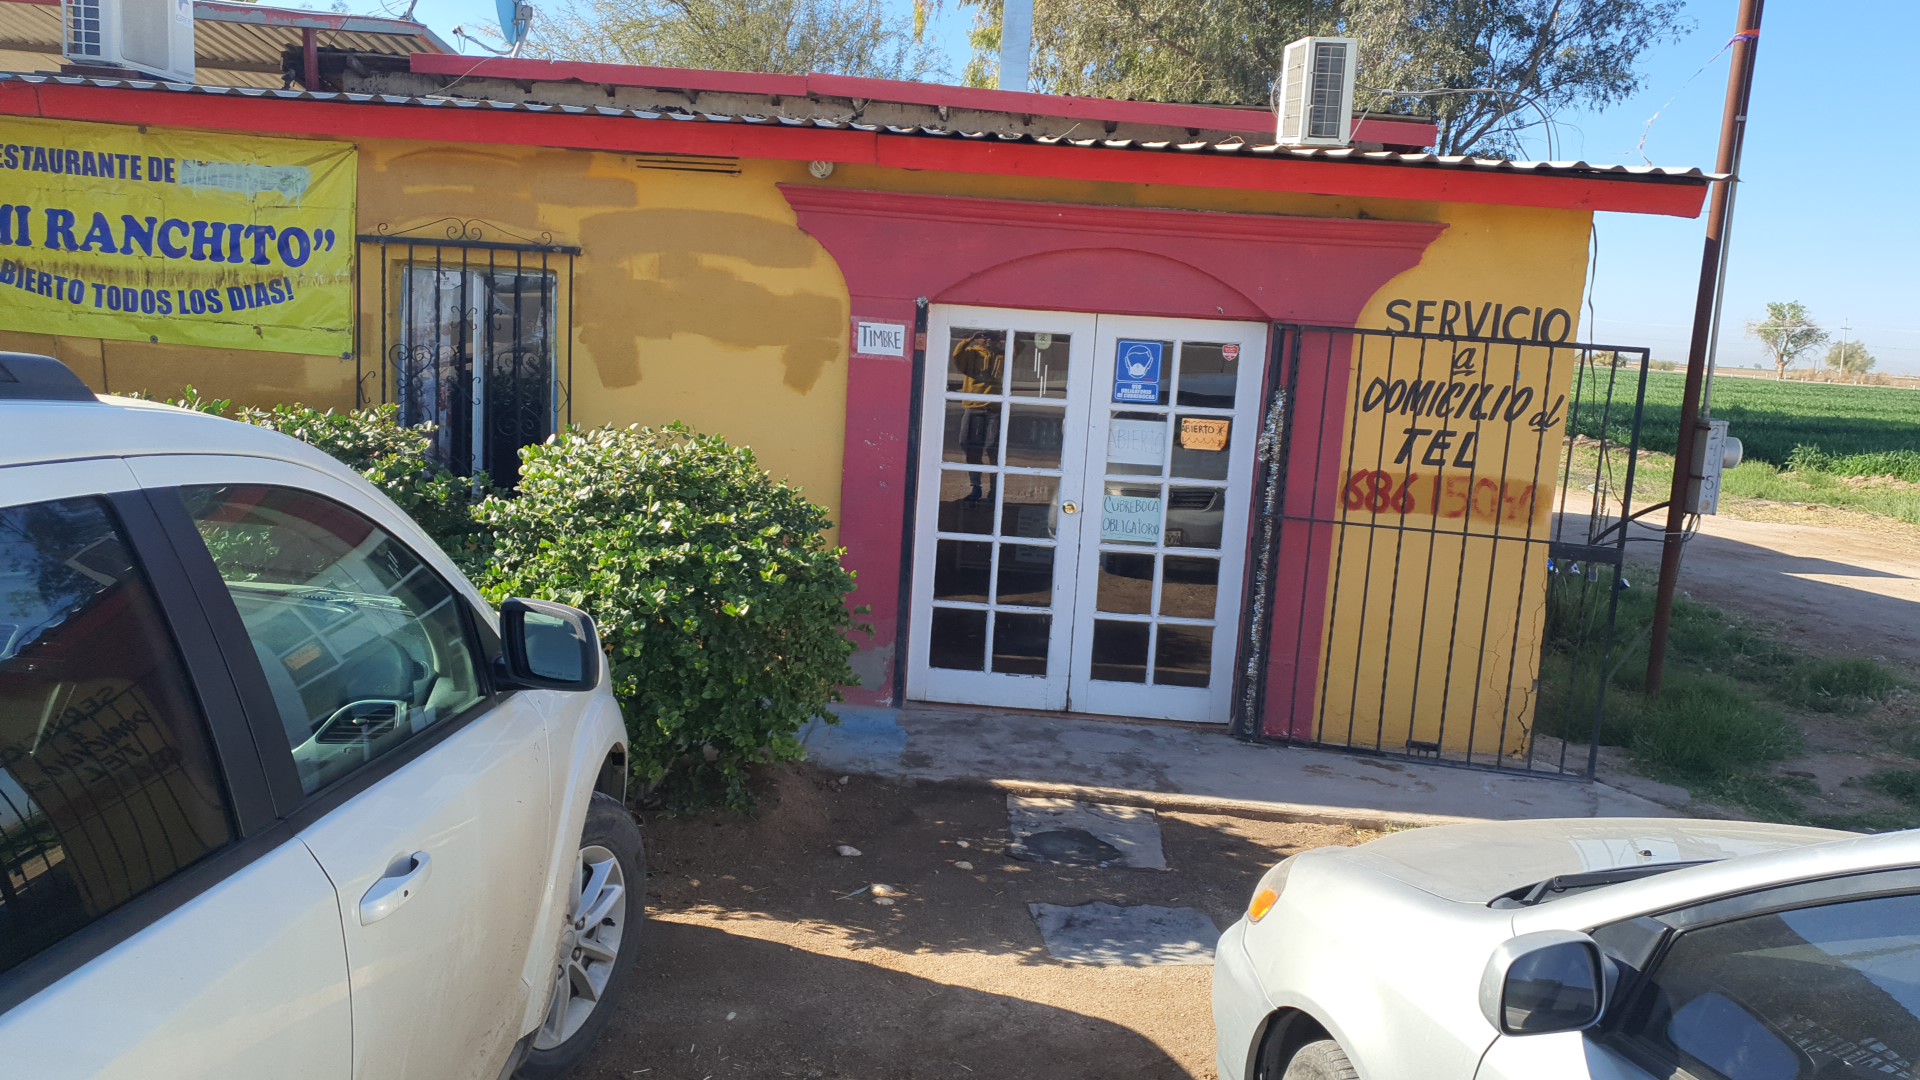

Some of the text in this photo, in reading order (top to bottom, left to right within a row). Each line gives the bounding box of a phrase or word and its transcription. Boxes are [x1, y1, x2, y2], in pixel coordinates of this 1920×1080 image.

[147, 156, 175, 183] DE
[91, 282, 173, 315] TODOS
[177, 288, 224, 315] LOS
[227, 276, 295, 312] DIAS!
[859, 325, 901, 349] TIMBRE
[1385, 299, 1572, 344] SERVICIO
[1362, 376, 1533, 422] DOMICILIO
[1182, 424, 1215, 434] ABIERTO
[1394, 427, 1476, 468] TEL
[1341, 468, 1418, 514] 686
